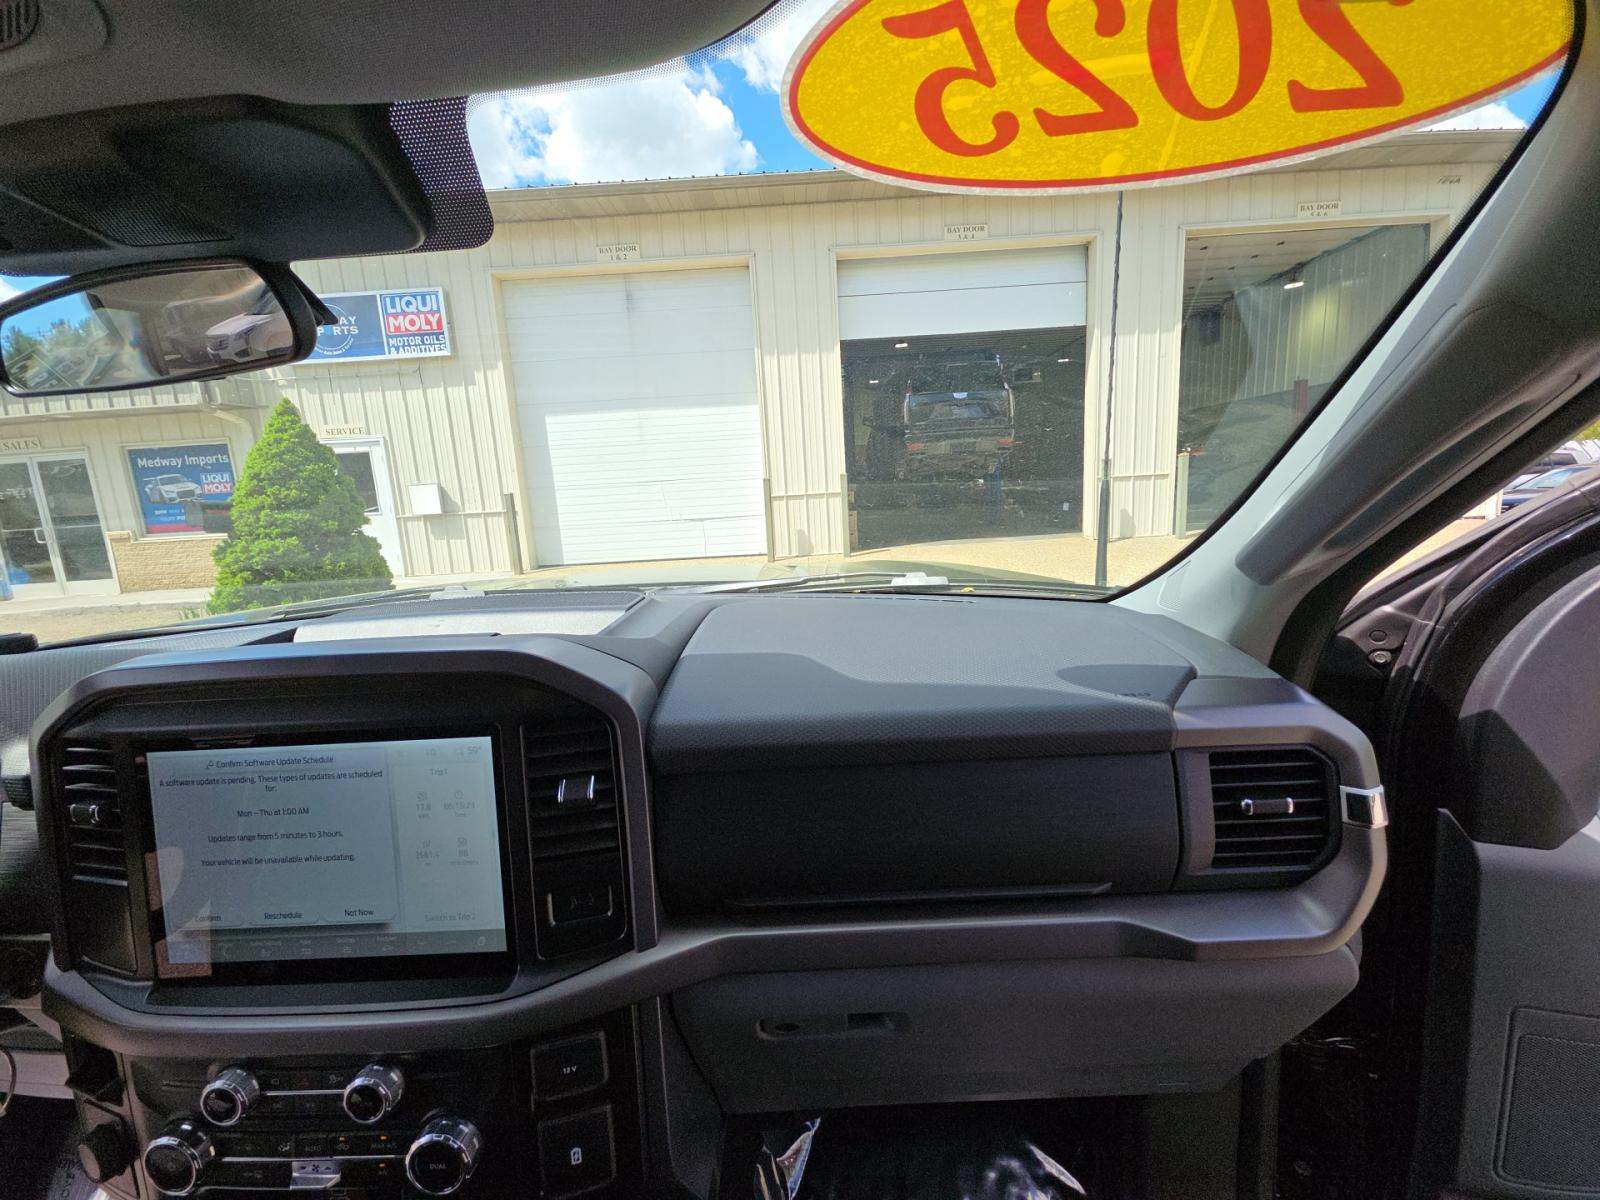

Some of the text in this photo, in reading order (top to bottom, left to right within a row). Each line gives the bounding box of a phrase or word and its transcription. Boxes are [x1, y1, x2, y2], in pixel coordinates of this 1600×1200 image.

[615, 245, 637, 253] DOOR
[385, 295, 439, 313] LIQUI
[388, 313, 441, 332] MOLY
[389, 334, 446, 347] MOTOR OILS
[398, 344, 447, 355] ADDITIVES
[325, 427, 365, 436] SERVICE
[2, 440, 39, 450] SALES
[137, 454, 229, 468] Medway Imports
[202, 473, 230, 483] LIQUI
[204, 483, 232, 493] MOLY
[216, 755, 334, 768] Confirm Software Update Schedule
[165, 778, 195, 787] software
[196, 777, 220, 786] update
[258, 774, 279, 783] These
[279, 773, 298, 783] types
[308, 772, 336, 781] updates
[348, 770, 383, 779] scheduled
[237, 809, 252, 817] Mon
[260, 808, 273, 816] Thu
[282, 807, 297, 815] 1:00
[297, 807, 309, 815] AM
[237, 834, 256, 843] range
[257, 832, 274, 841] from
[280, 831, 308, 839] minutes
[309, 831, 316, 839] to
[201, 858, 217, 866] Your
[217, 857, 241, 866] vehicle
[242, 856, 253, 865] will
[254, 856, 263, 865] be
[264, 855, 303, 865] unavailable
[303, 854, 322, 863] while
[264, 912, 303, 920] Reschedule
[344, 908, 375, 917] Not Now
